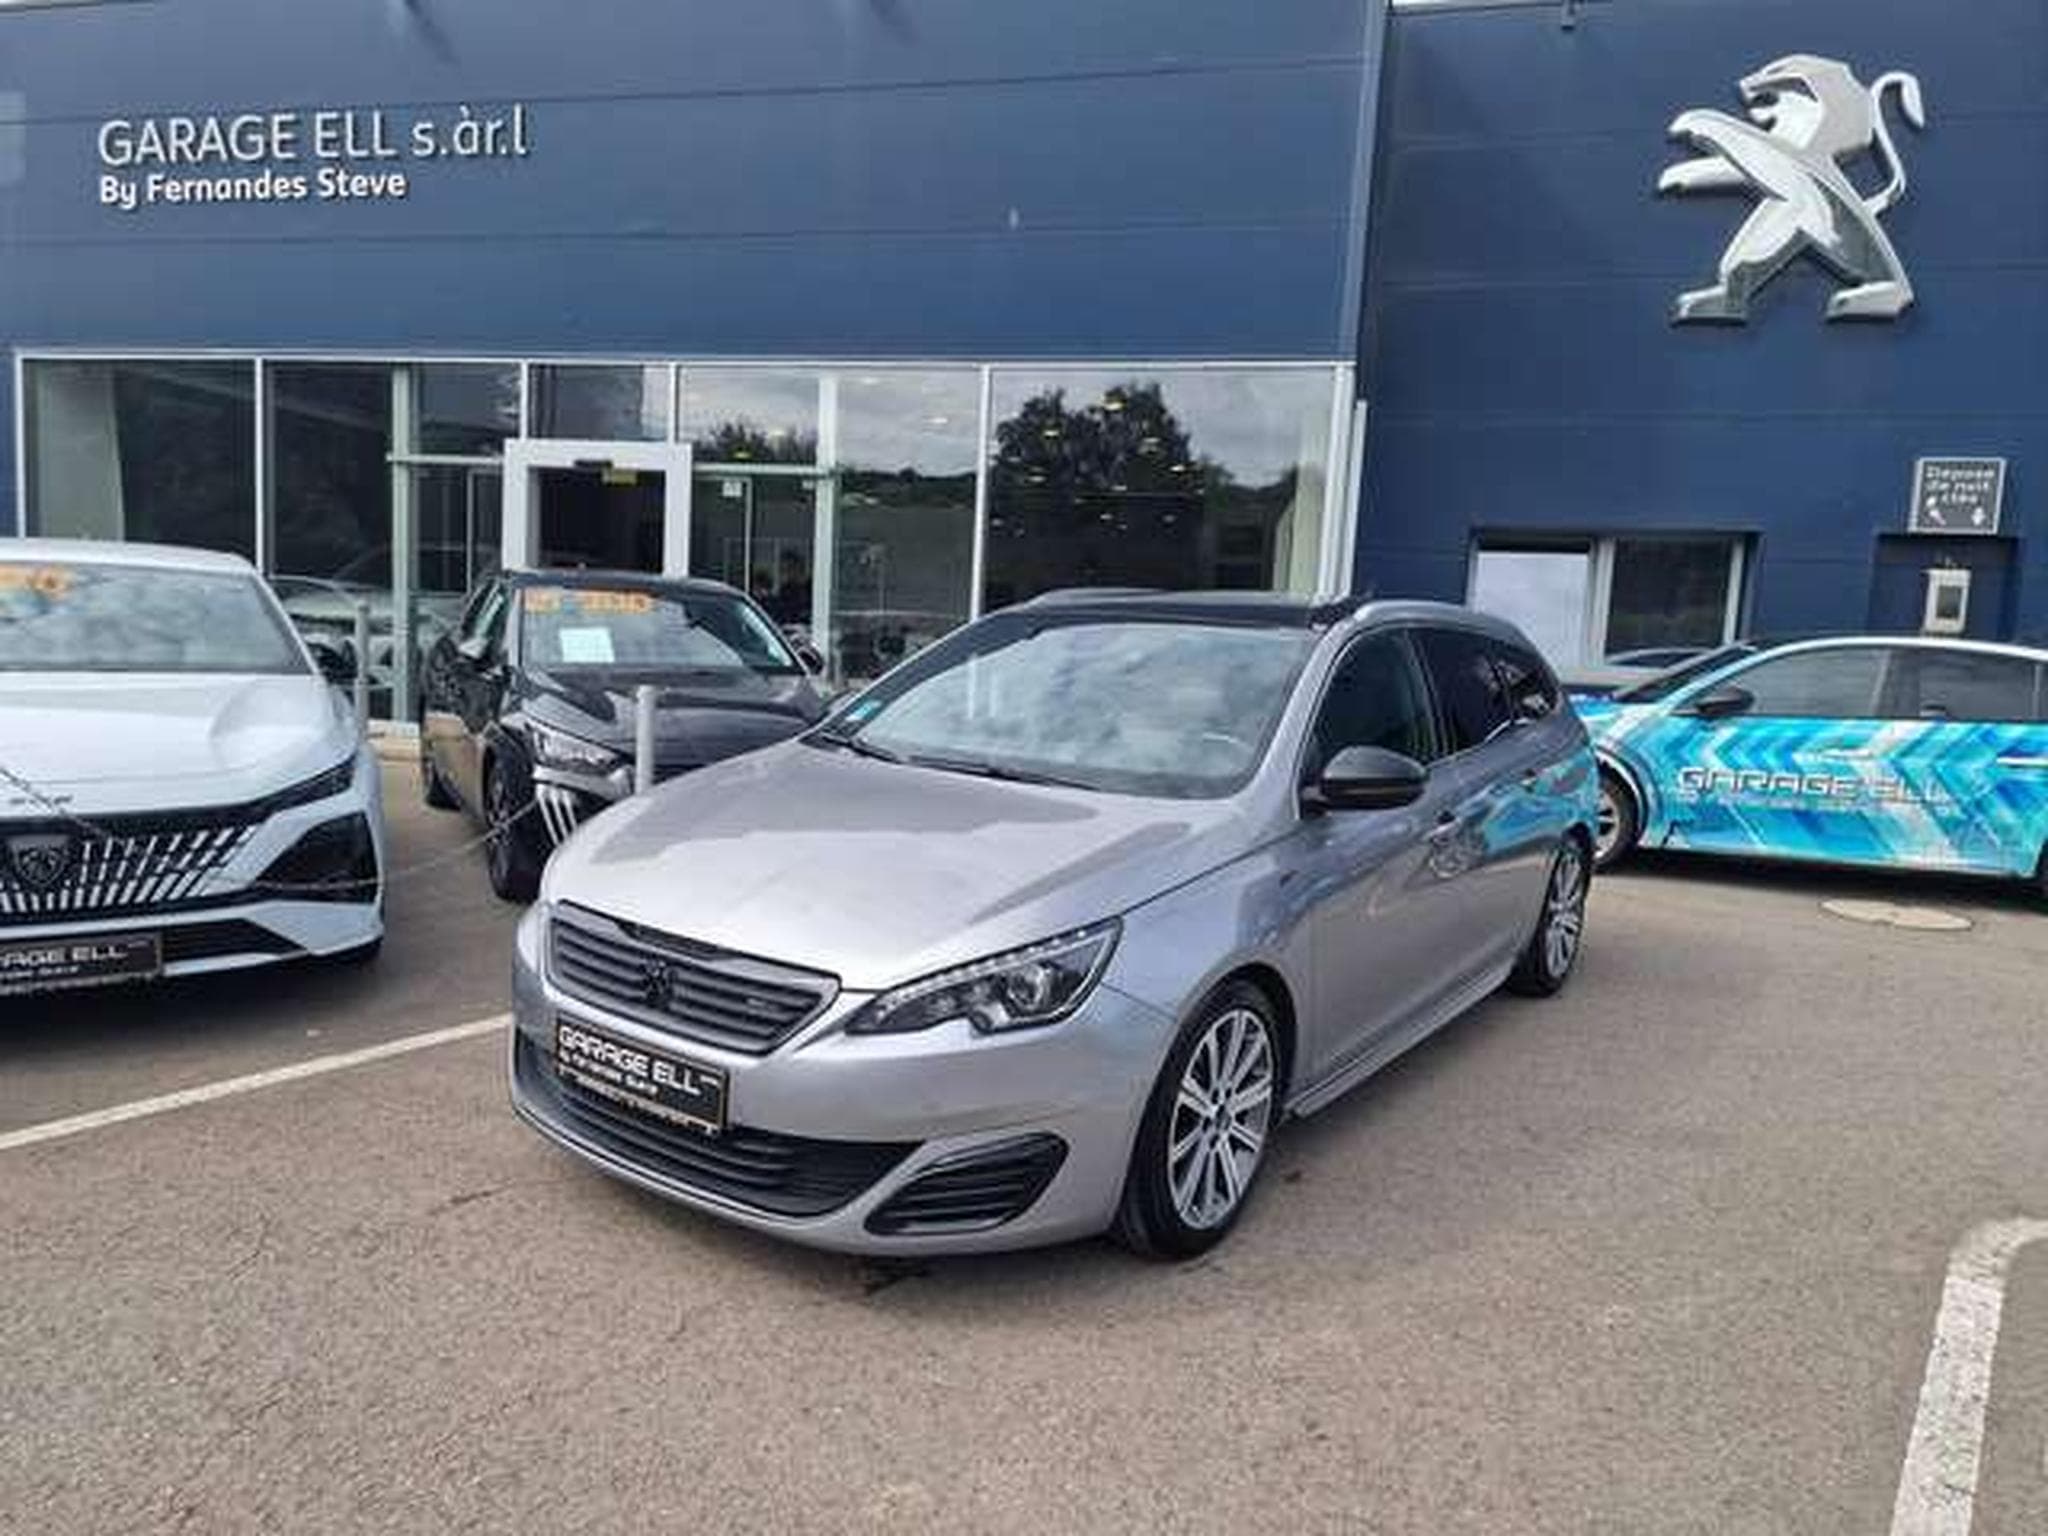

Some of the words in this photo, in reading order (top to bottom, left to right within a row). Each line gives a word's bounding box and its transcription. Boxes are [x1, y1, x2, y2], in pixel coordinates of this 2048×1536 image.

[98, 114, 297, 166] GARAGE
[314, 110, 397, 159] ELL
[100, 174, 137, 210] By
[147, 169, 308, 203] Fernandes
[317, 168, 407, 198] Steve
[1678, 765, 1858, 801] GARAGE
[559, 1026, 650, 1077] GARAGE
[652, 1059, 702, 1096] ELL
